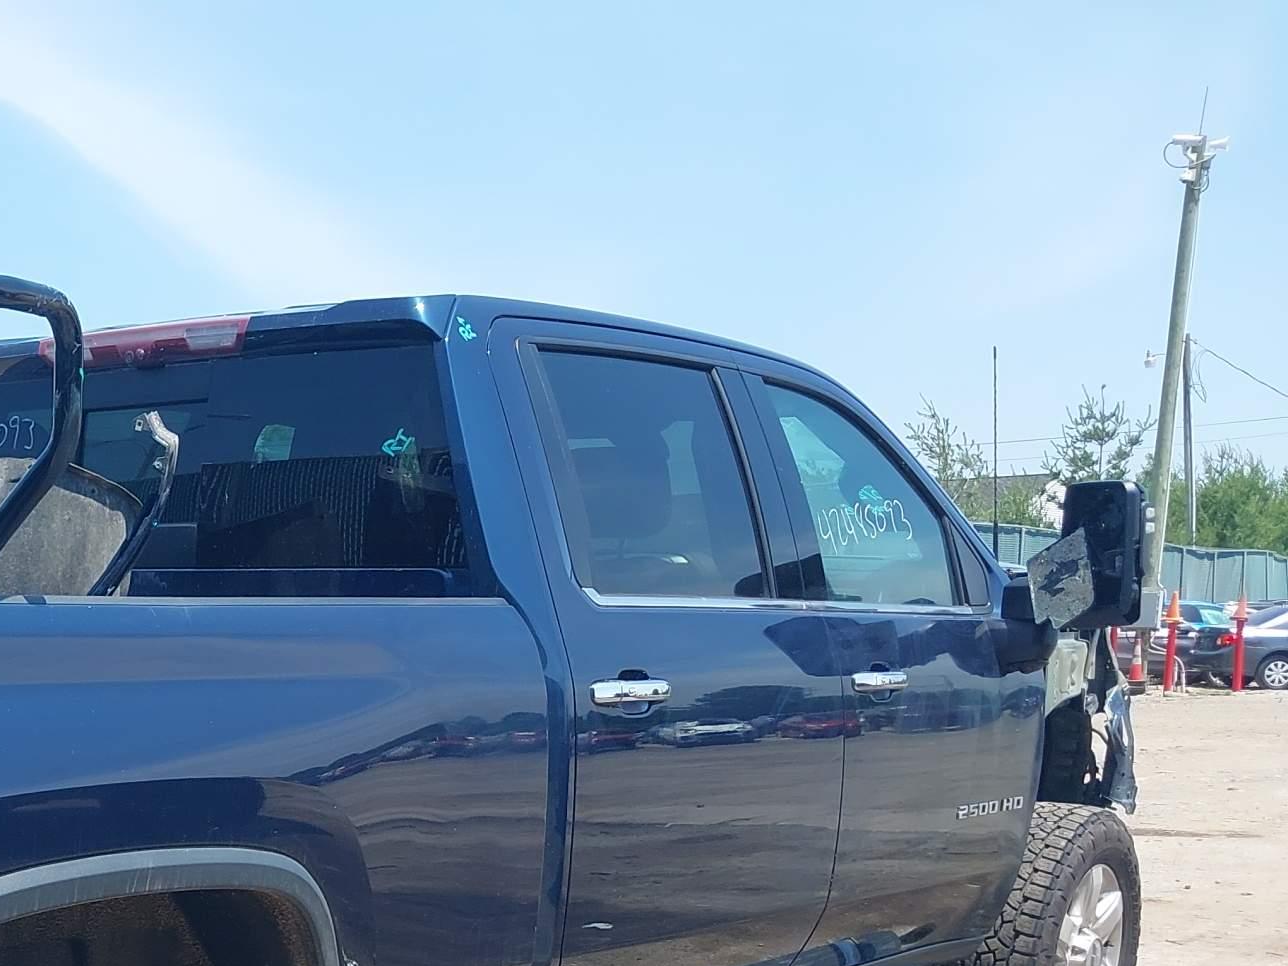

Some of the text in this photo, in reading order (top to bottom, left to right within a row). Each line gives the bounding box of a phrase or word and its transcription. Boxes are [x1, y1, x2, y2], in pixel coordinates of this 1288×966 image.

[817, 499, 913, 556] 42485093
[956, 796, 1024, 820] 2500 HD
